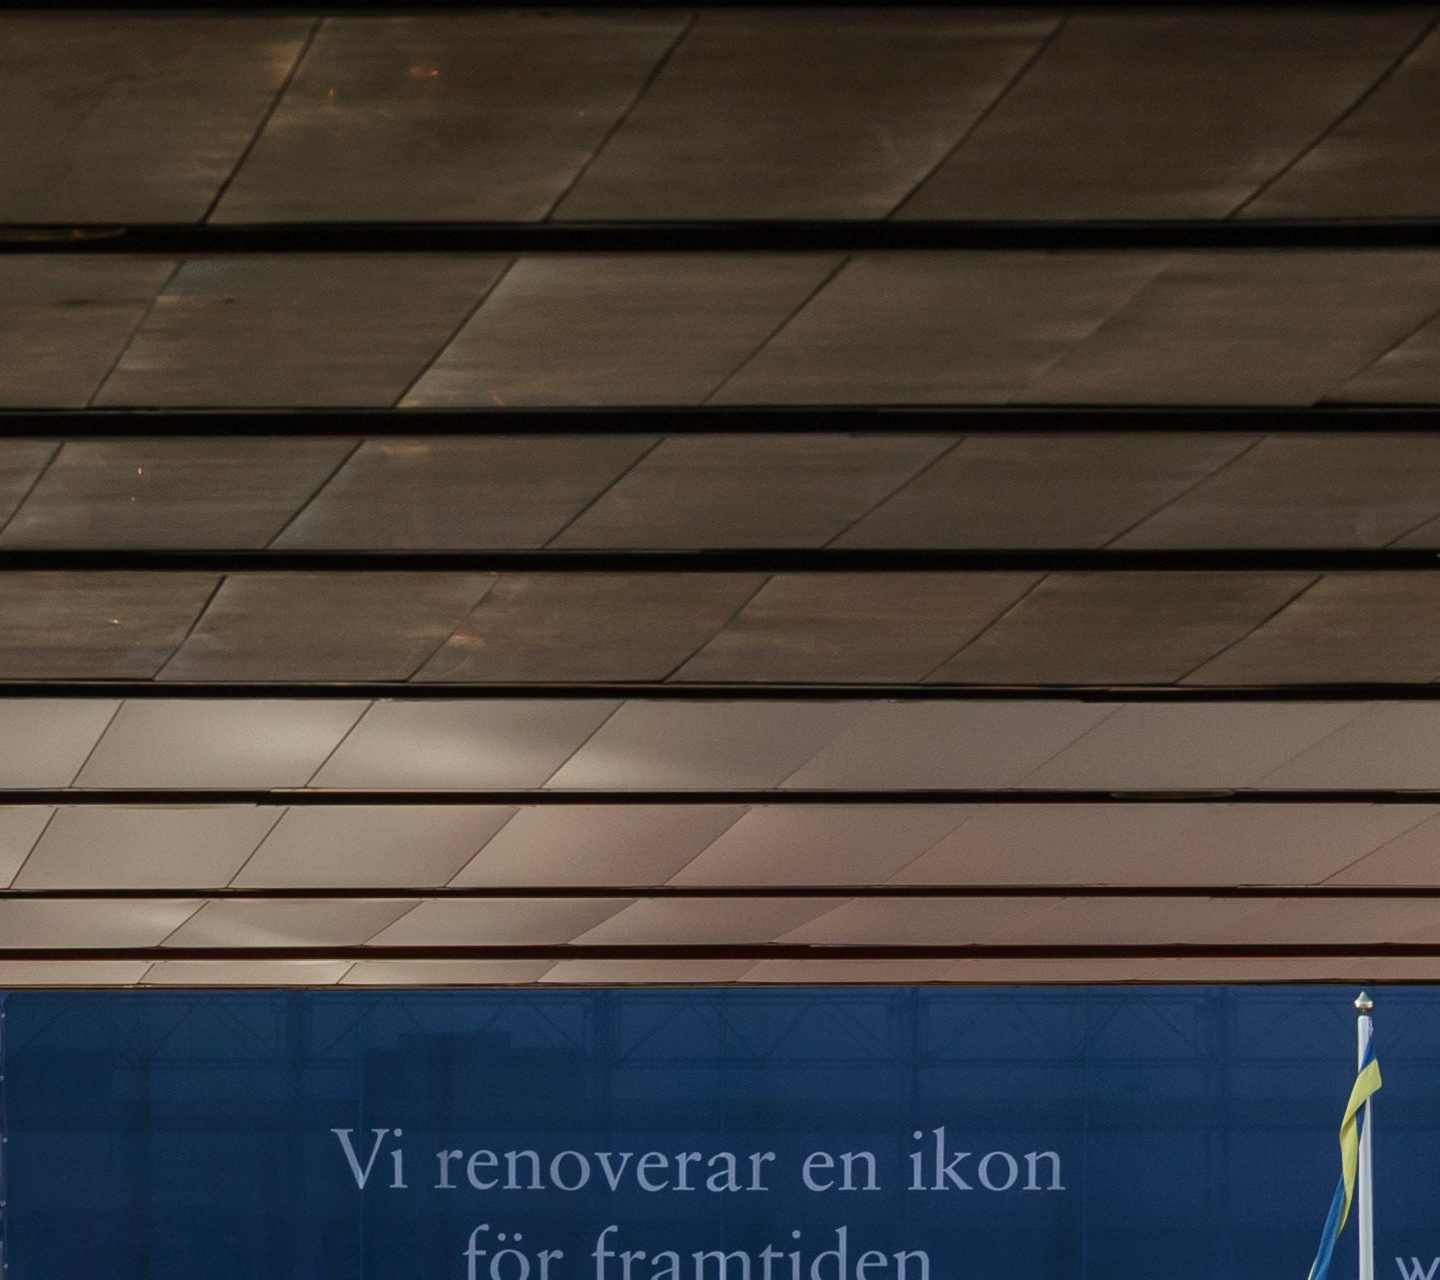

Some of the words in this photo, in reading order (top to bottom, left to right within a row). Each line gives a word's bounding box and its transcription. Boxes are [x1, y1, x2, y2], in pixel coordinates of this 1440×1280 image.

[331, 1127, 408, 1191] Vi
[434, 1138, 778, 1193] renoverar
[802, 1146, 882, 1192] en
[907, 1126, 1067, 1193] ikon
